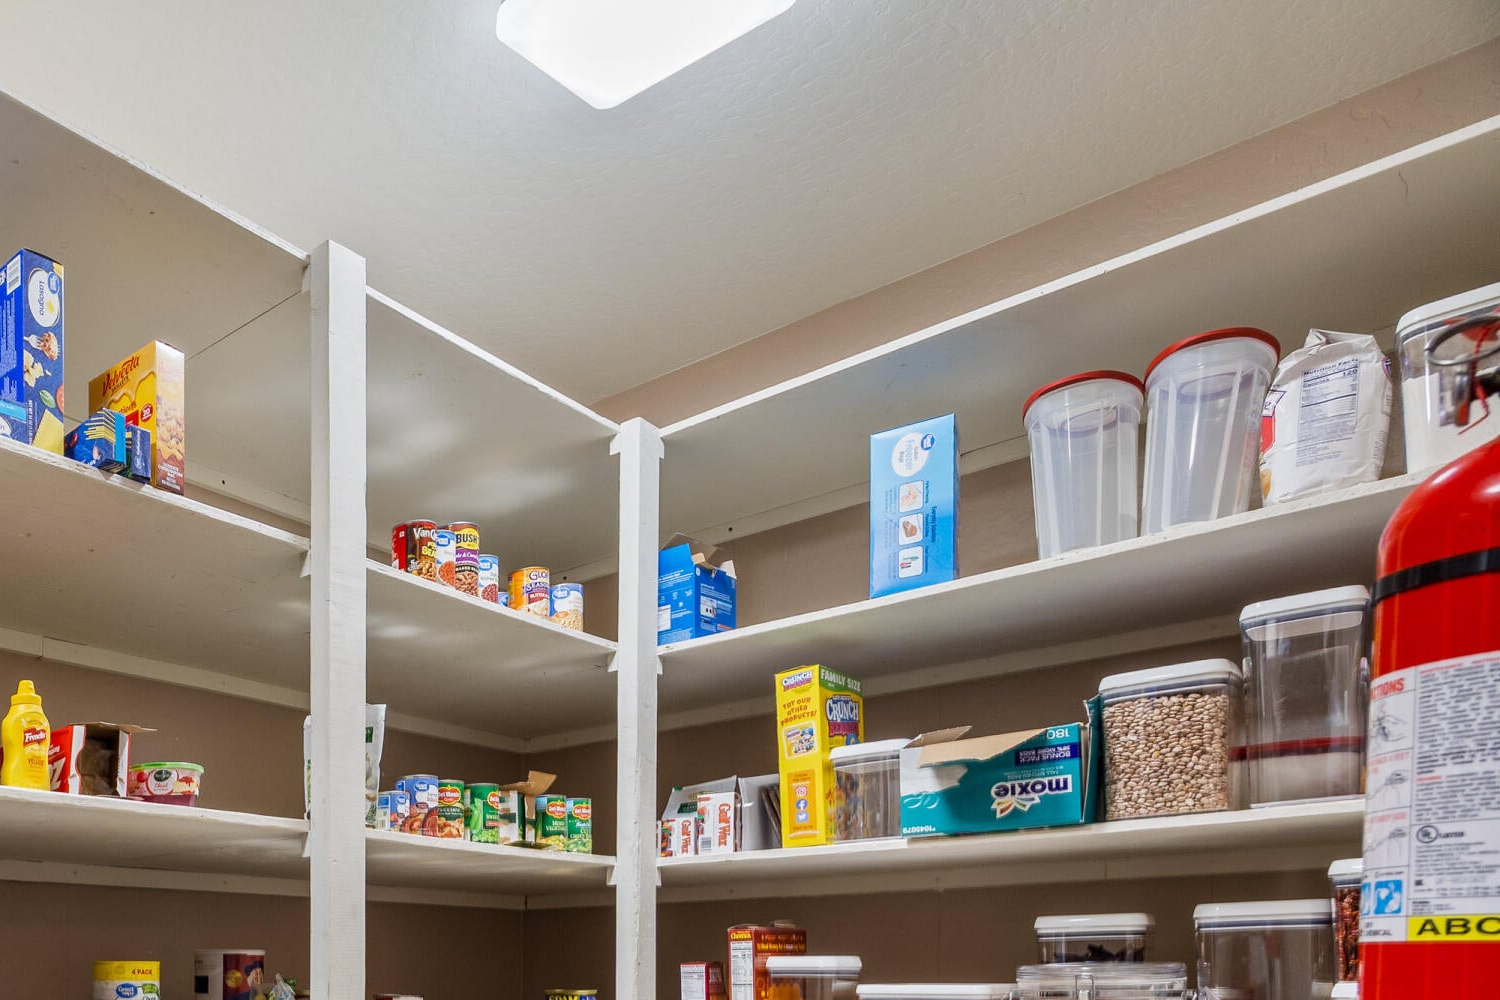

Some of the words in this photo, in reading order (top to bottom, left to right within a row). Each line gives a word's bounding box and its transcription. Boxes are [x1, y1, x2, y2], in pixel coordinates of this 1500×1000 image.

[820, 669, 846, 686] FAMILY
[847, 679, 861, 691] SIZE
[826, 699, 859, 722] CRUNCH
[1046, 728, 1071, 740] 180
[994, 777, 1069, 799] moxie
[137, 968, 153, 976] PACK
